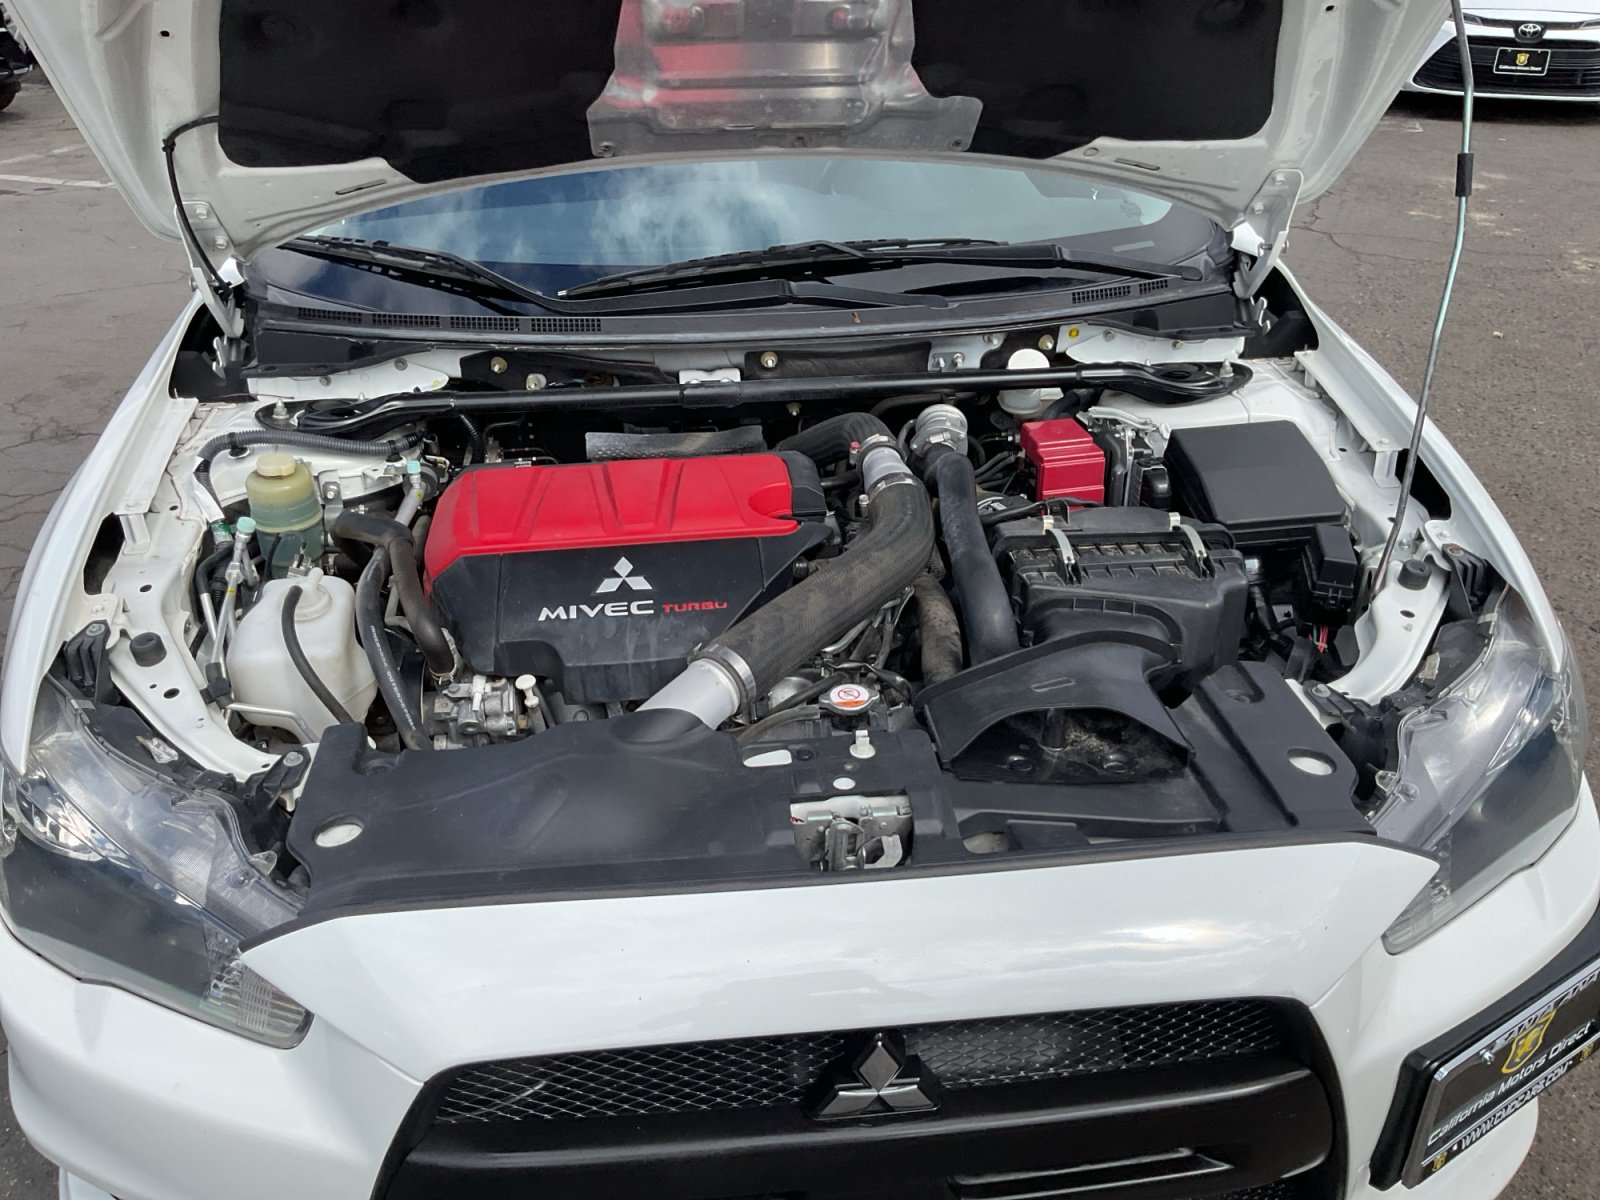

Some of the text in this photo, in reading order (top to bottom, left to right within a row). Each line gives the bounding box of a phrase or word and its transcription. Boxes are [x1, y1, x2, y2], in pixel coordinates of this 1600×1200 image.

[537, 600, 655, 622] MIVEC
[1427, 1021, 1591, 1146] California Motors Direct
